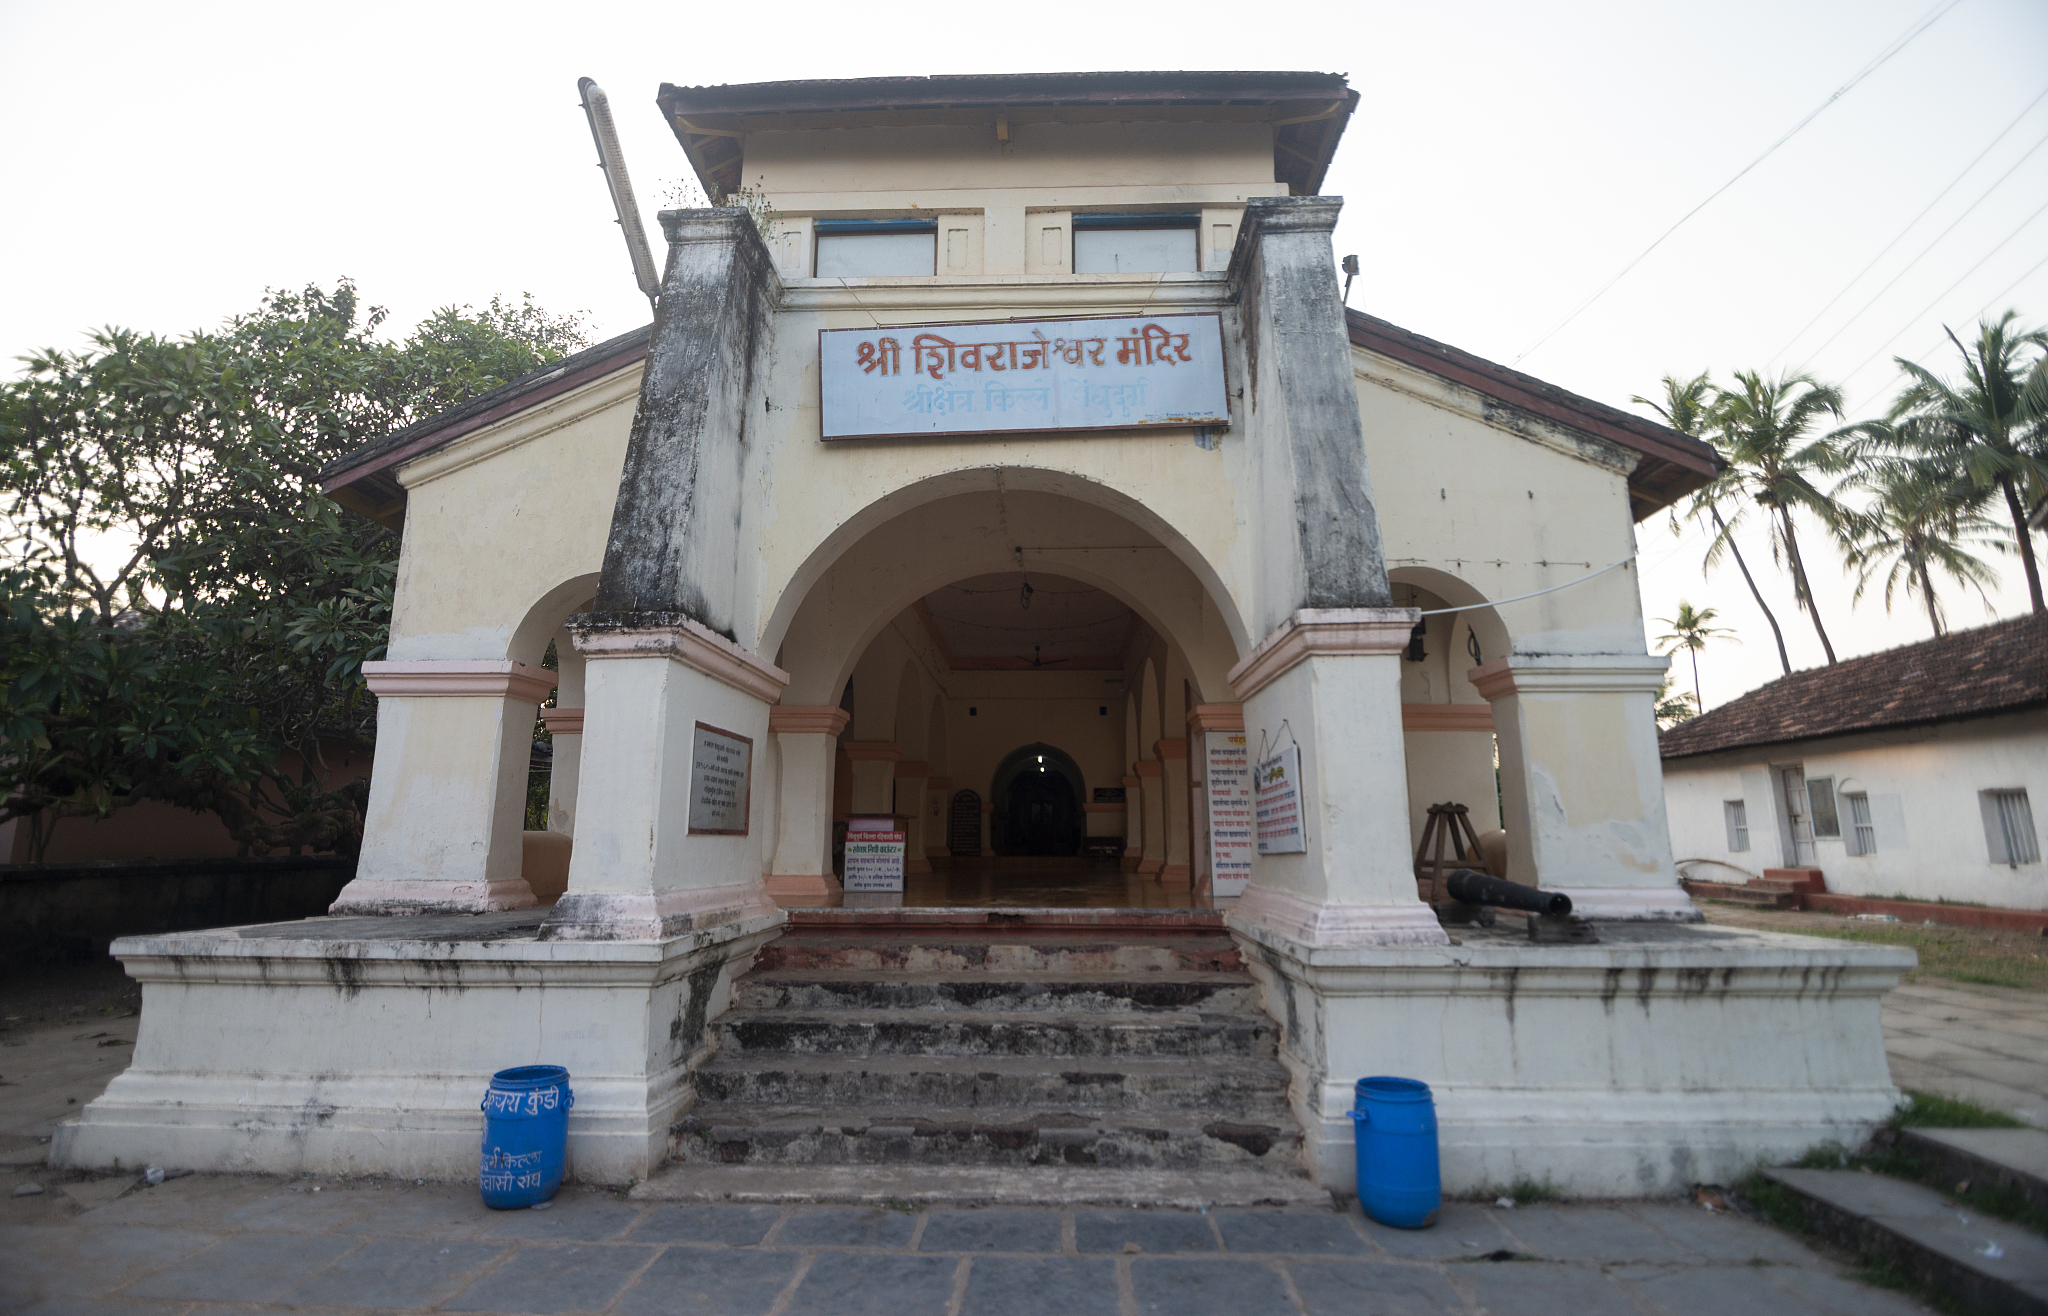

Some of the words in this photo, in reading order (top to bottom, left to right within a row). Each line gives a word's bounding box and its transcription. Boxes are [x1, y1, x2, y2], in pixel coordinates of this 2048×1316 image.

[857, 336, 901, 377] श्री
[911, 329, 1108, 379] शिवराजेश्वर
[1116, 324, 1193, 366] मंदिर
[486, 1089, 526, 1113] कचरा
